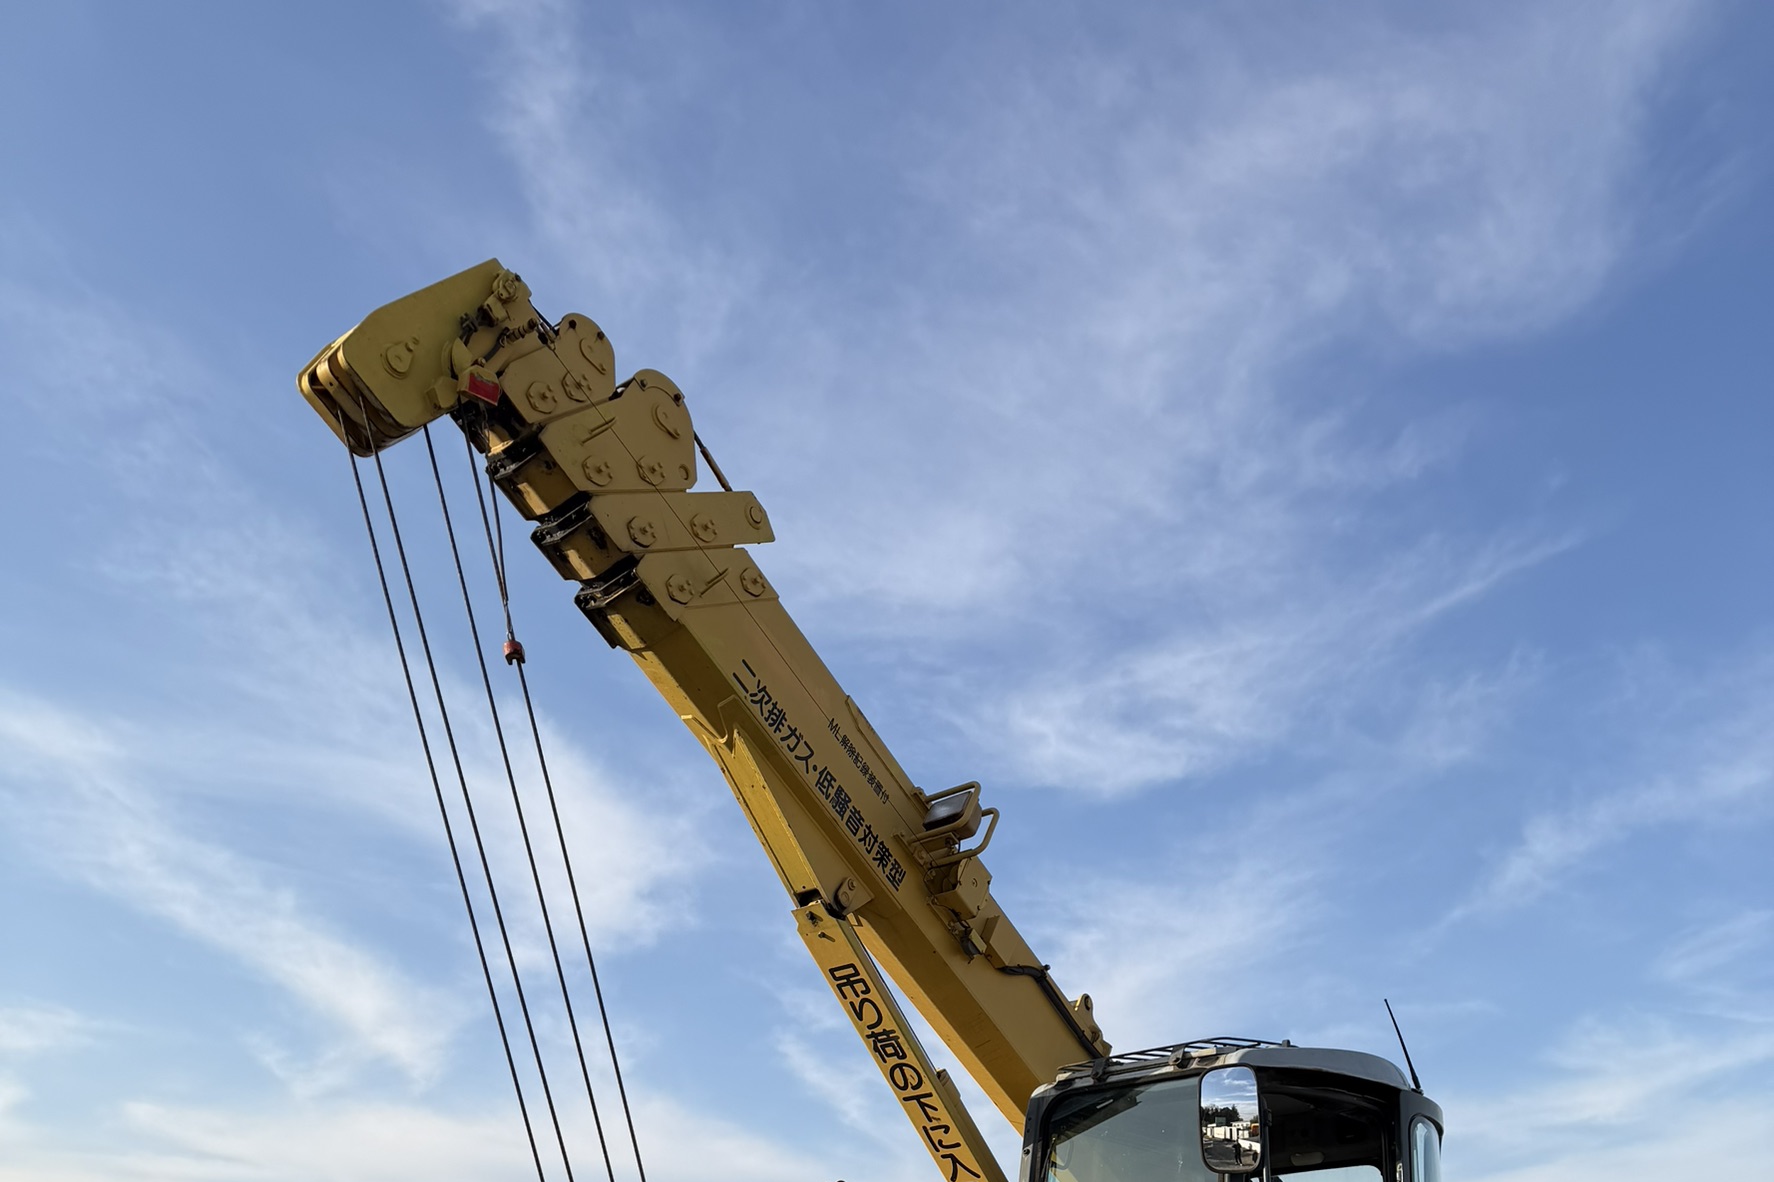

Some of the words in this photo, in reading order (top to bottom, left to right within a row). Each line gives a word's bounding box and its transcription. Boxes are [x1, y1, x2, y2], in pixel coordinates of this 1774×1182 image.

[733, 659, 906, 892] 二次排ガス・低騒音対策型
